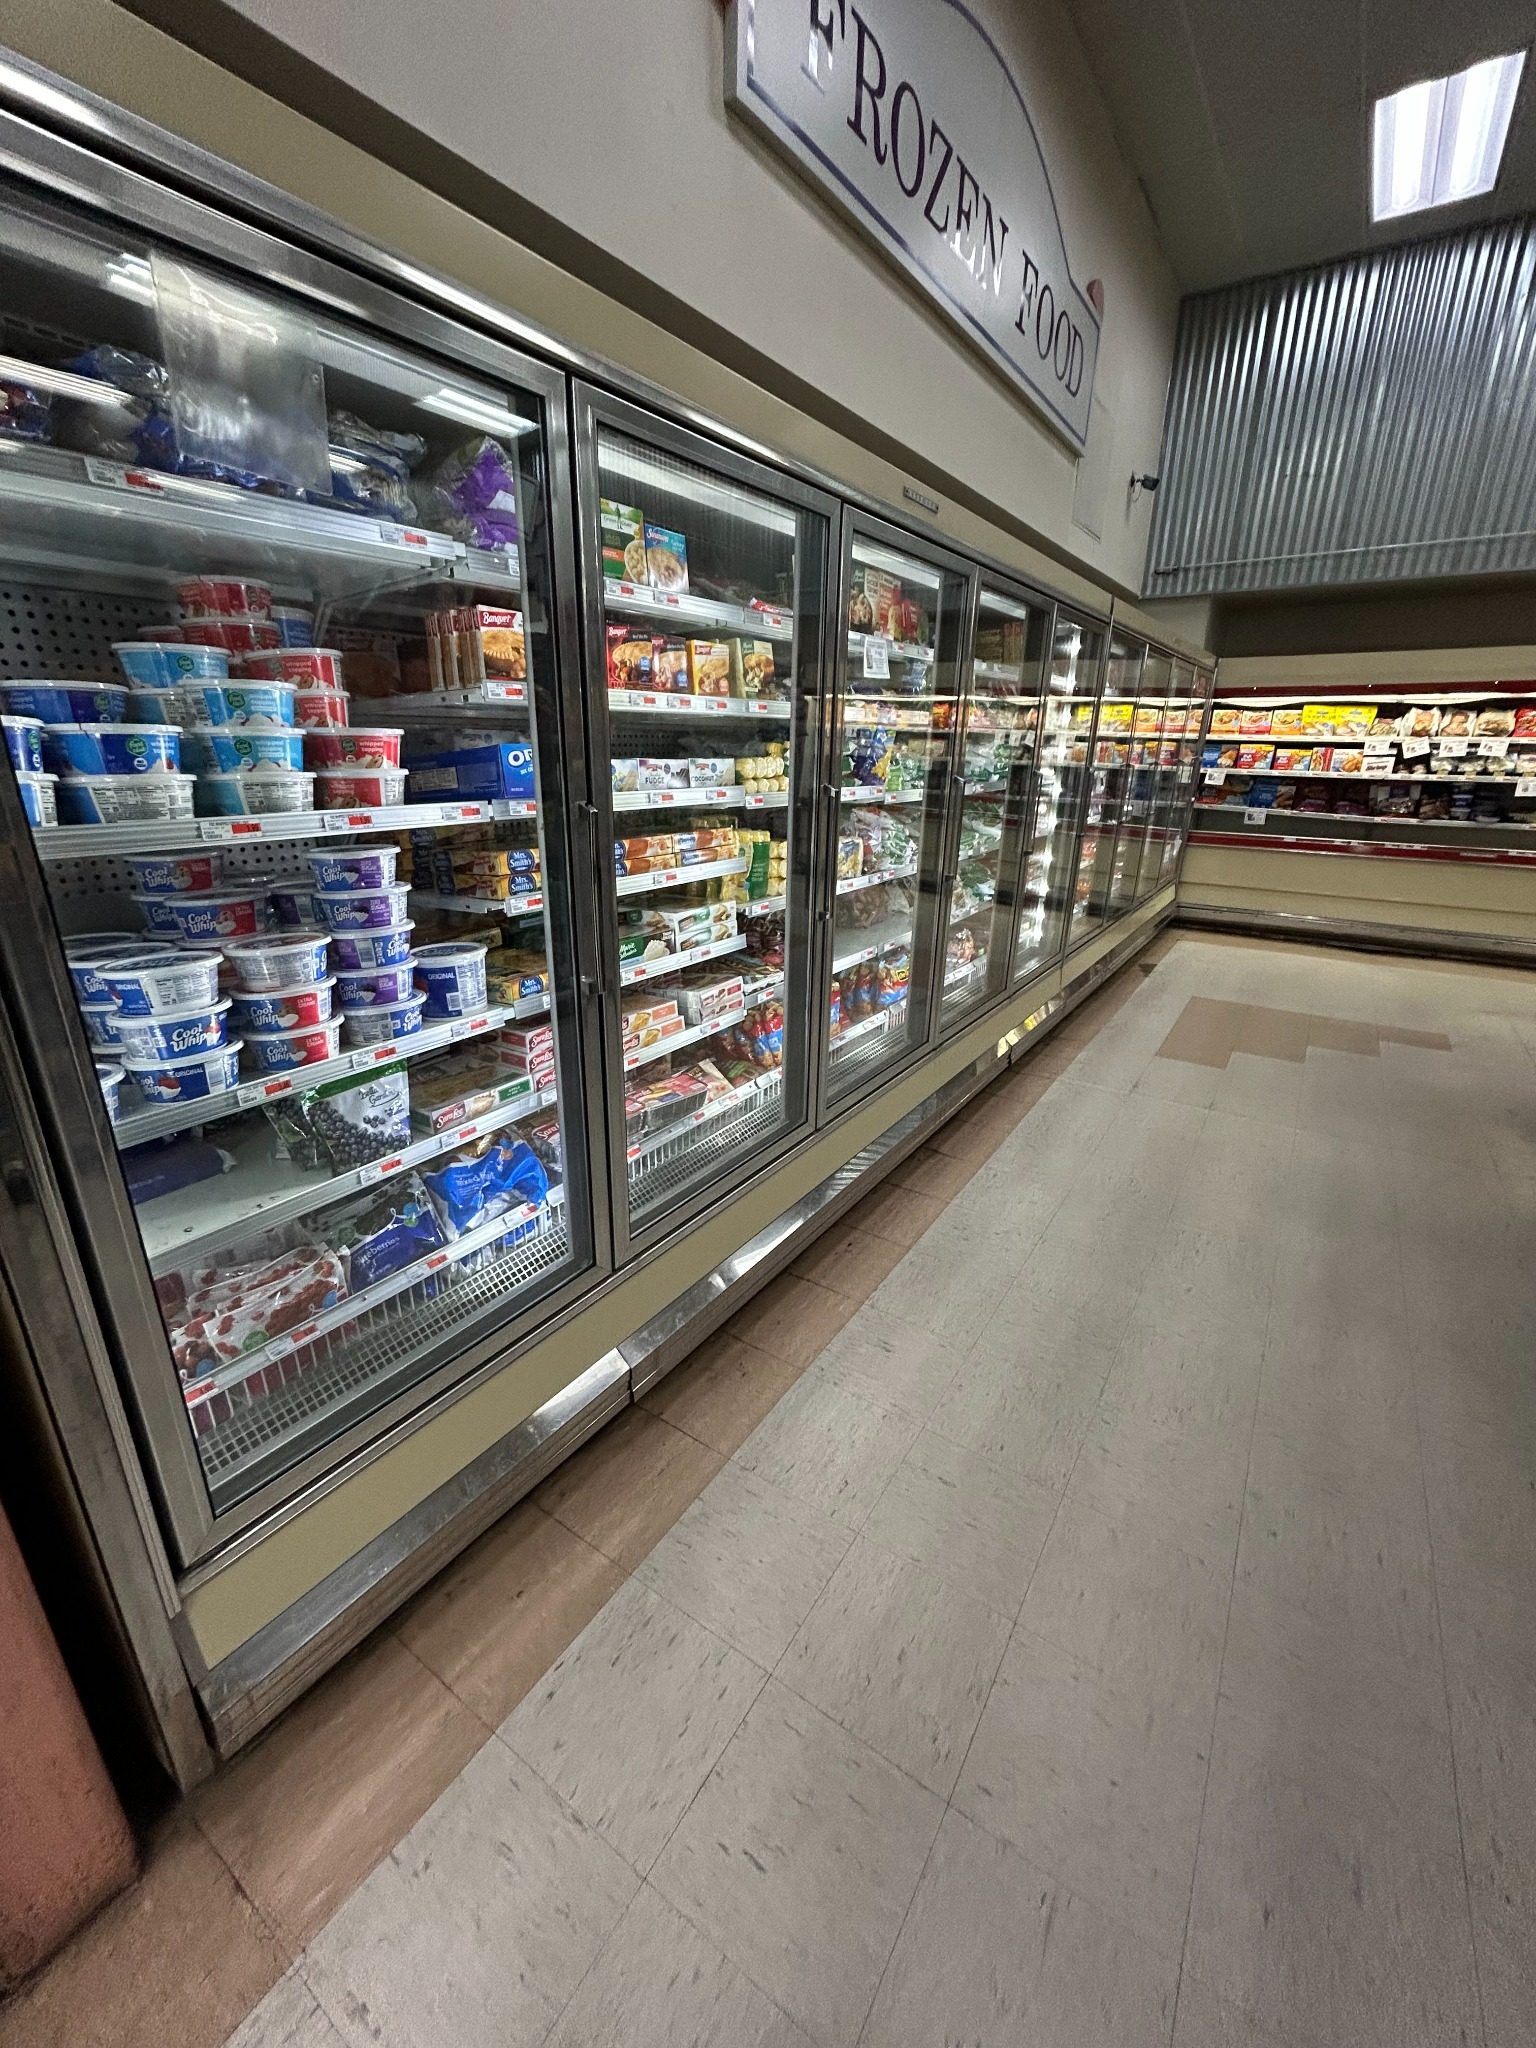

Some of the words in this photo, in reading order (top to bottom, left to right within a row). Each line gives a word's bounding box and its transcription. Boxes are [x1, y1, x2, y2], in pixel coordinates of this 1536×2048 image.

[800, 0, 1009, 297] FROZEN
[1014, 249, 1084, 398] FOOD
[483, 611, 512, 625] Banquet
[513, 851, 527, 860] Mrs.
[510, 858, 532, 868] Smith's
[145, 867, 168, 878] Cool
[322, 864, 342, 875] Cool
[146, 874, 174, 887] Whip
[323, 871, 346, 883] Whip
[514, 876, 528, 884] Mrs.
[511, 882, 533, 893] Smith's
[333, 903, 351, 914] Cool
[187, 911, 212, 923] Cool
[334, 910, 356, 921] Whip
[188, 920, 217, 934] Whip
[428, 972, 456, 980] ORIGINAL
[339, 983, 357, 993] Cool
[340, 990, 362, 1000] Whip
[250, 1004, 273, 1017] Cool
[252, 1013, 279, 1027] Whip
[172, 1023, 203, 1042] Cool
[170, 1032, 207, 1052] Whip
[267, 1045, 288, 1056] Cool
[267, 1051, 291, 1063] Whip
[174, 1067, 204, 1077] ORIGINAL
[436, 1113, 453, 1129] Sara
